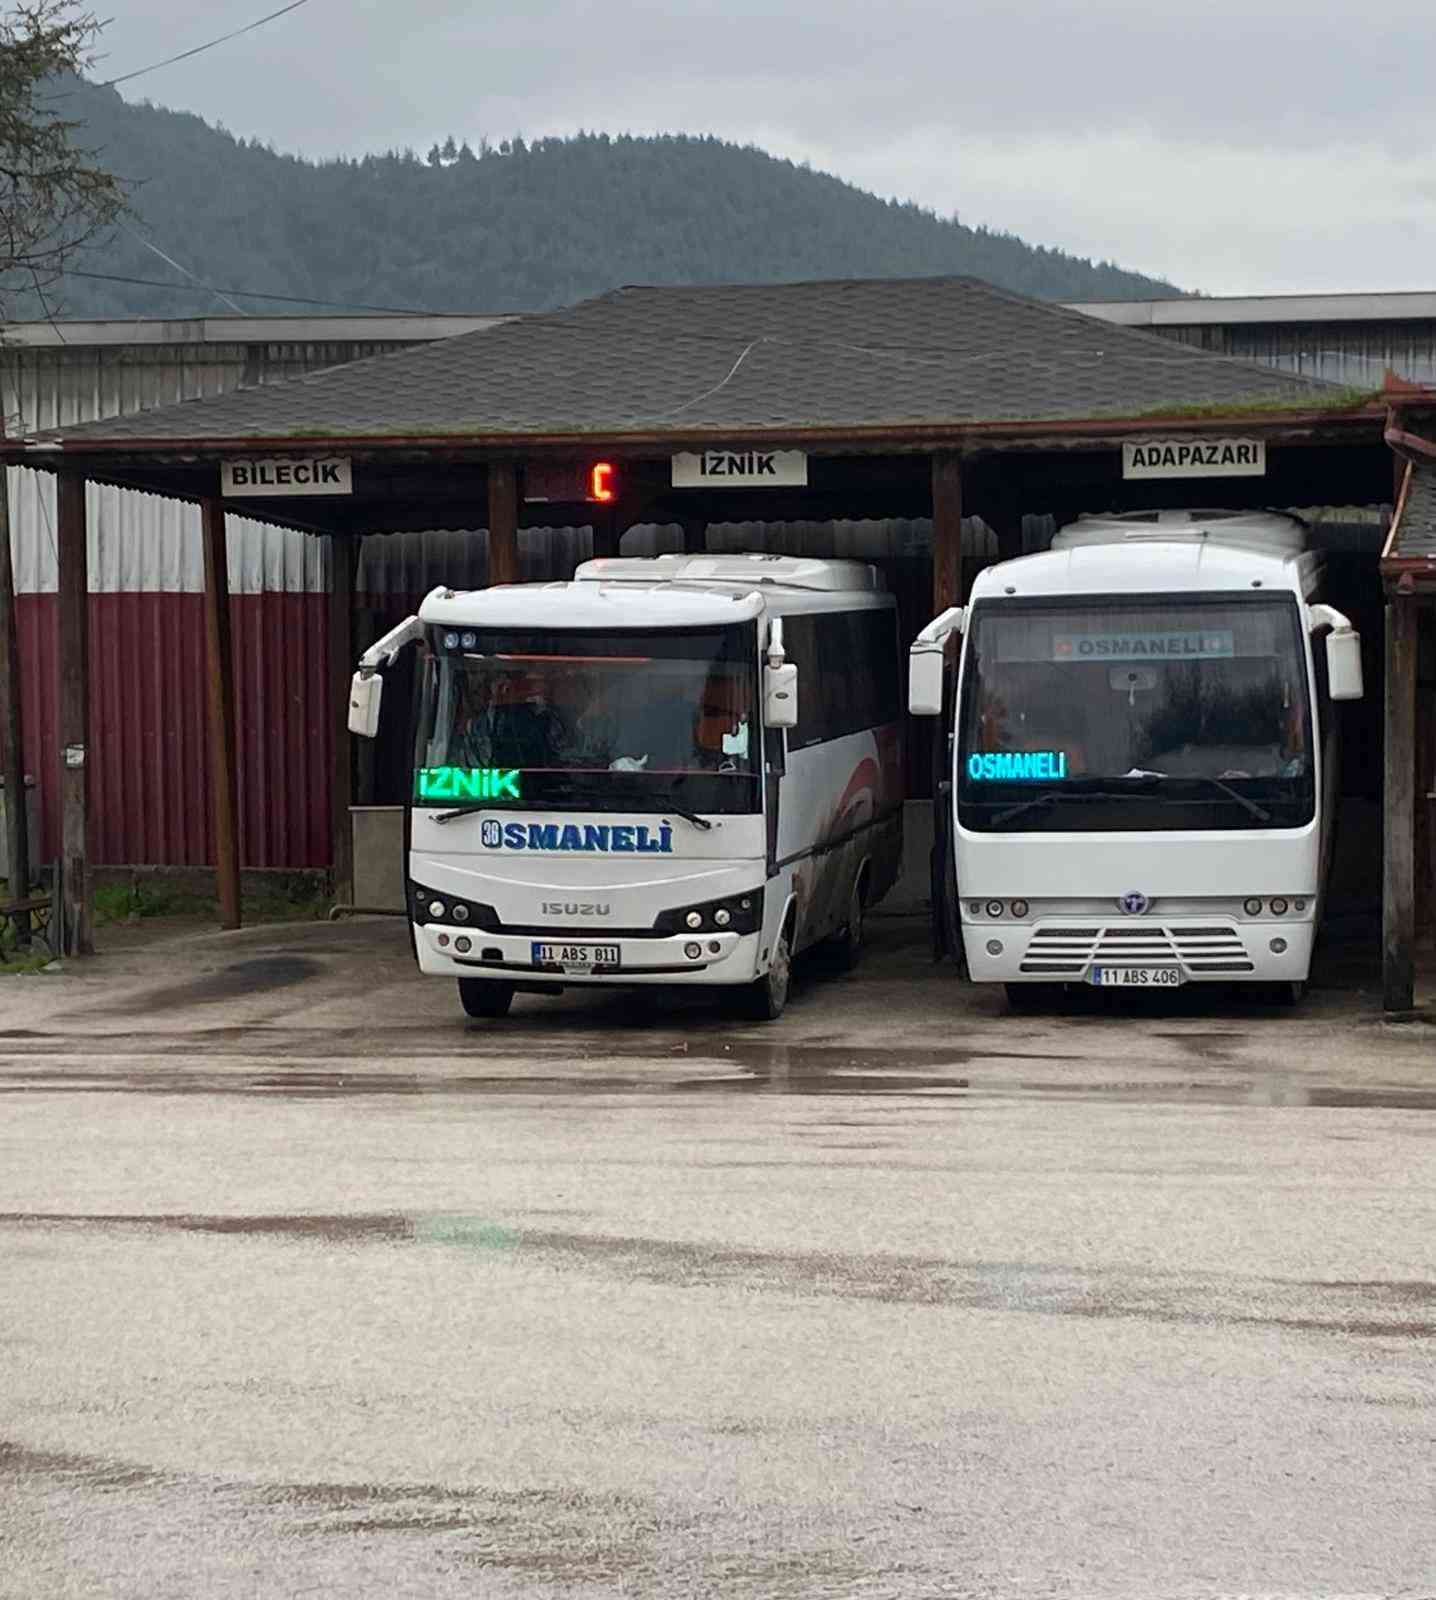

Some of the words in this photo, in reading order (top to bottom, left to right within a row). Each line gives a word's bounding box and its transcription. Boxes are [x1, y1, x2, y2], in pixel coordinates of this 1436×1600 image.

[1132, 444, 1258, 466] ADAPAZARI
[232, 460, 341, 485] BİLECİK
[420, 766, 520, 798] İZNİK
[541, 903, 611, 916] ISUZU
[542, 947, 555, 960] 11
[561, 948, 588, 961] ABS
[1104, 970, 1118, 984] 11
[1123, 970, 1148, 984] ABS
[1153, 970, 1178, 984] 406
